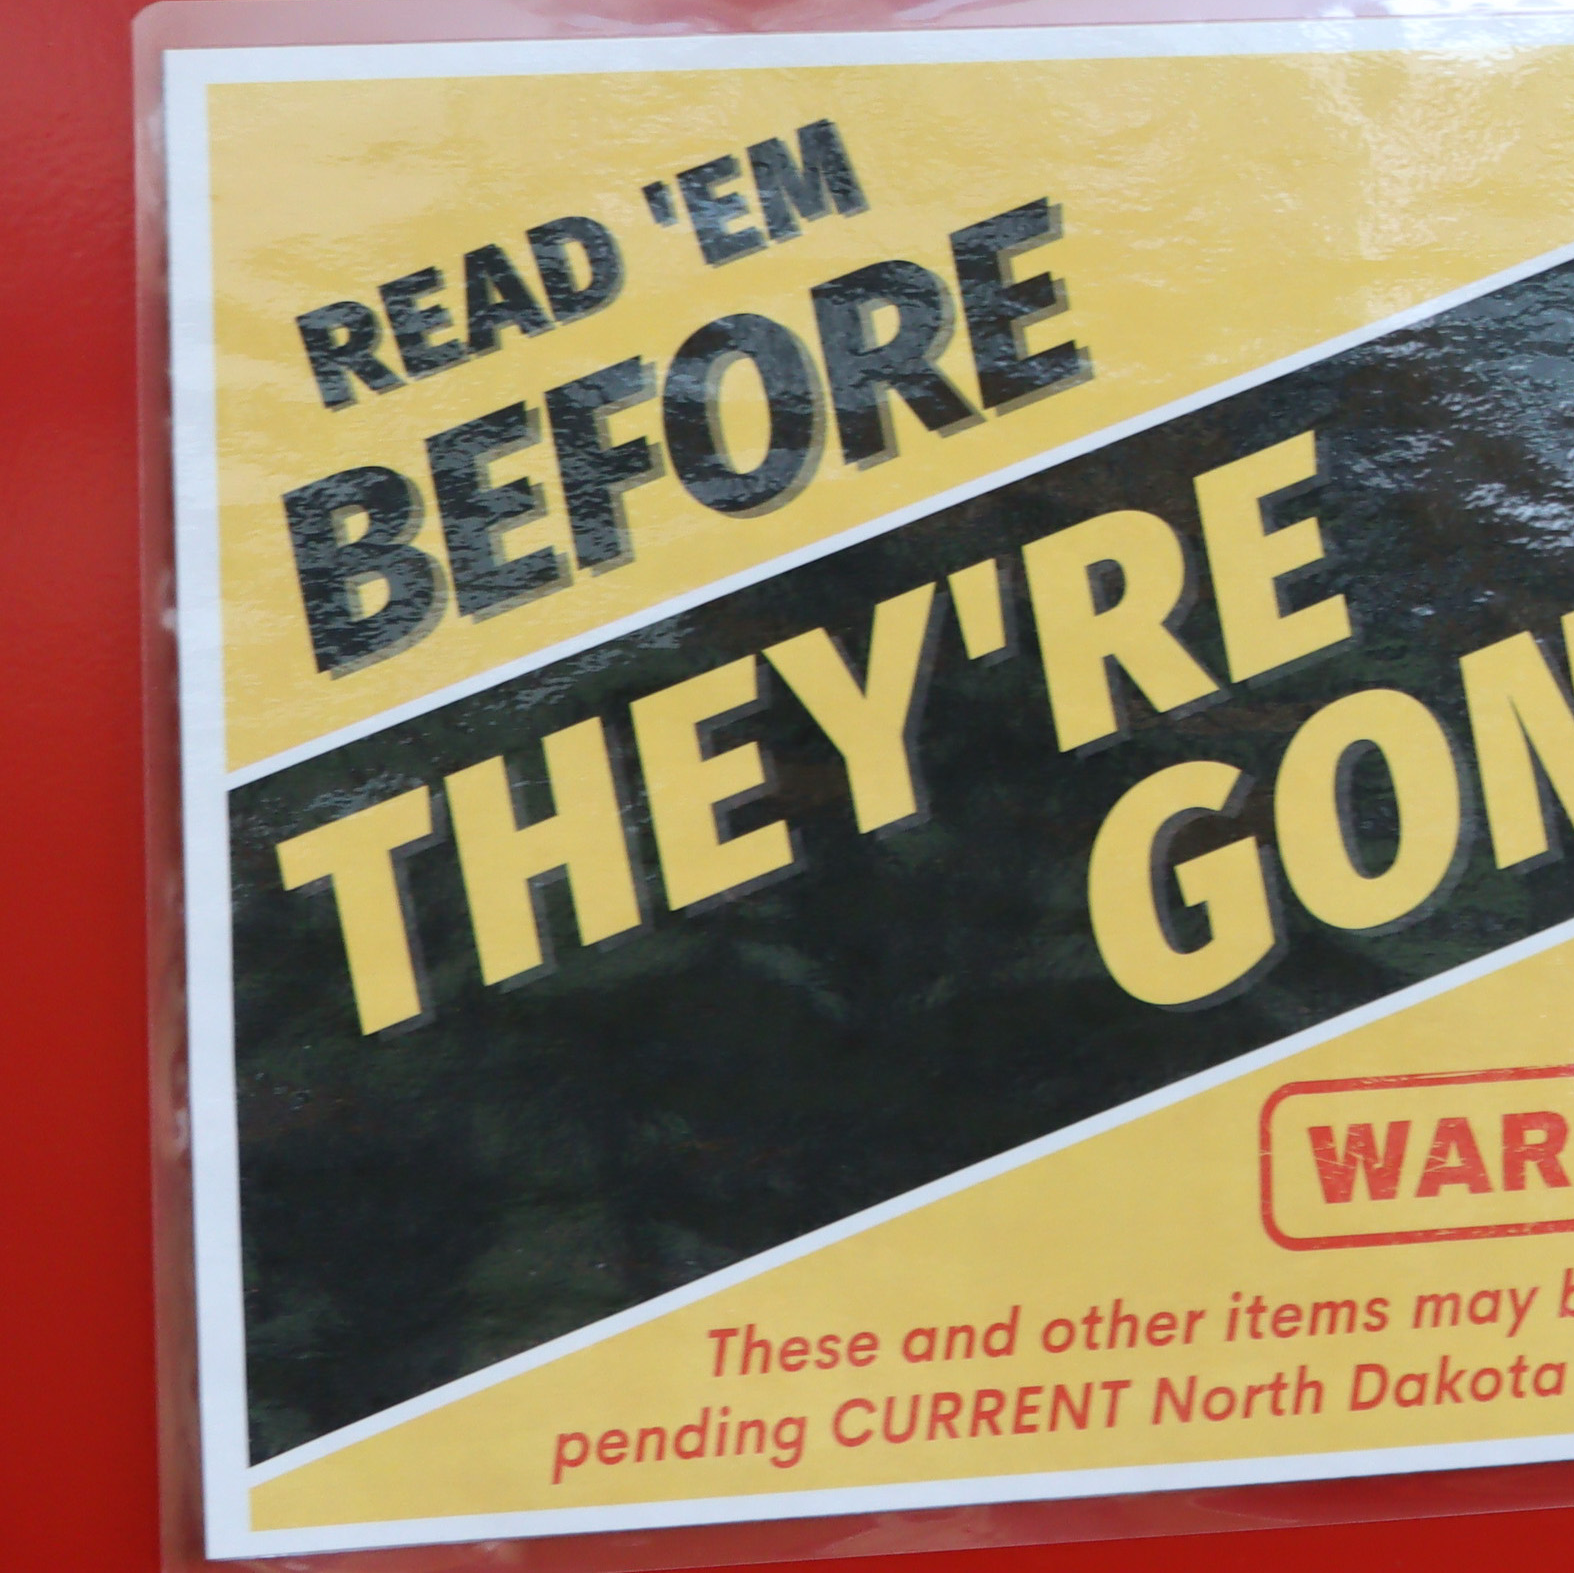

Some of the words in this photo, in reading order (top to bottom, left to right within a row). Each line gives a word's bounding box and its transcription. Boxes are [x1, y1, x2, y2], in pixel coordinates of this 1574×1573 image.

[294, 214, 626, 412] READ
[641, 117, 871, 267] 'EM
[281, 195, 1095, 680] BEFORE
[276, 429, 1358, 1039] THEY'RE
[550, 1406, 808, 1485] pending
[830, 1378, 1132, 1449] CURRENT
[1151, 1364, 1325, 1426] North
[1348, 1353, 1568, 1412] Dakota
[707, 1323, 881, 1378] These
[900, 1304, 1022, 1364] and
[1039, 1297, 1206, 1354] other
[1225, 1290, 1390, 1342] items
[1411, 1280, 1540, 1338] may
